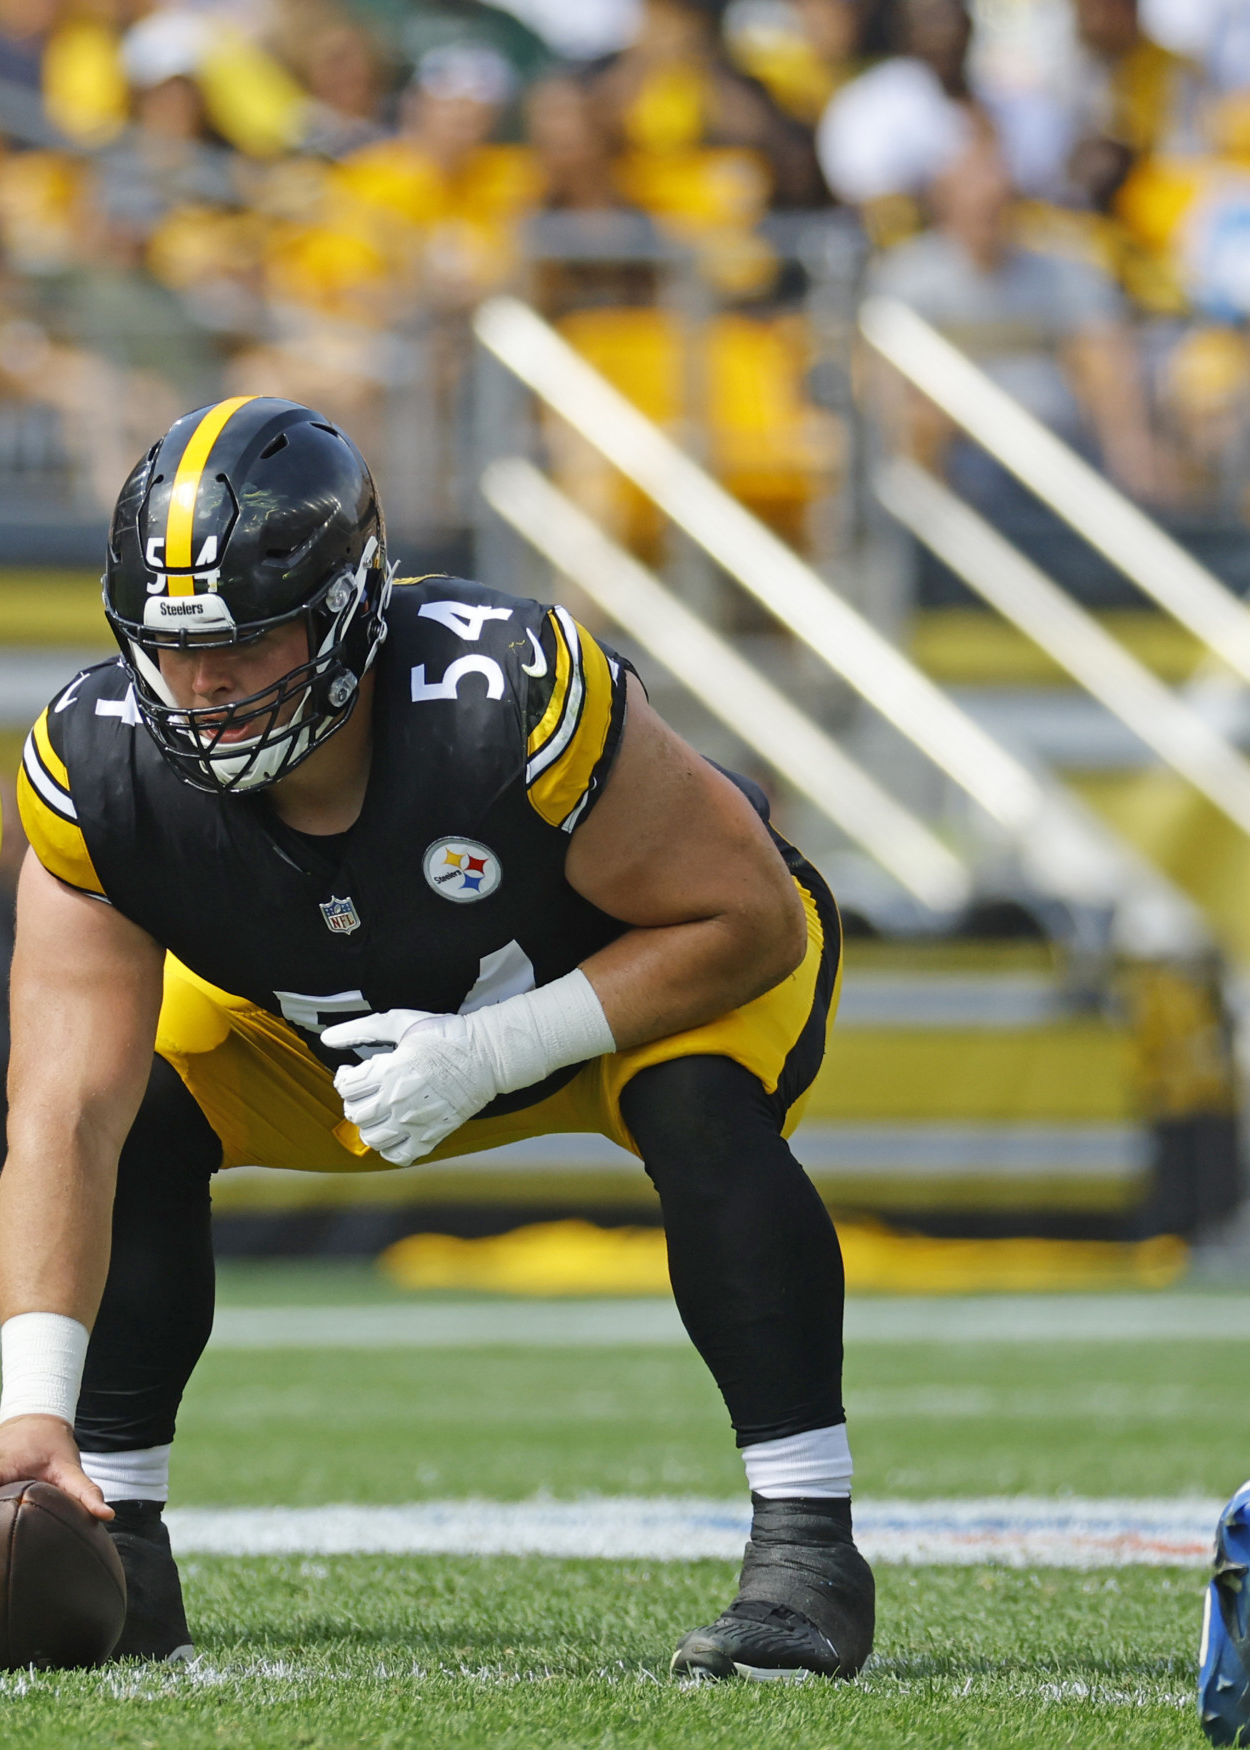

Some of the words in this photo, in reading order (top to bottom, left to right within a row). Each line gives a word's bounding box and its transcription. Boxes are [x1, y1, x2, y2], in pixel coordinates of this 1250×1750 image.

[160, 601, 204, 616] Steelers
[410, 600, 514, 703] 54
[433, 868, 462, 885] Steelers
[331, 914, 354, 929] NFL
